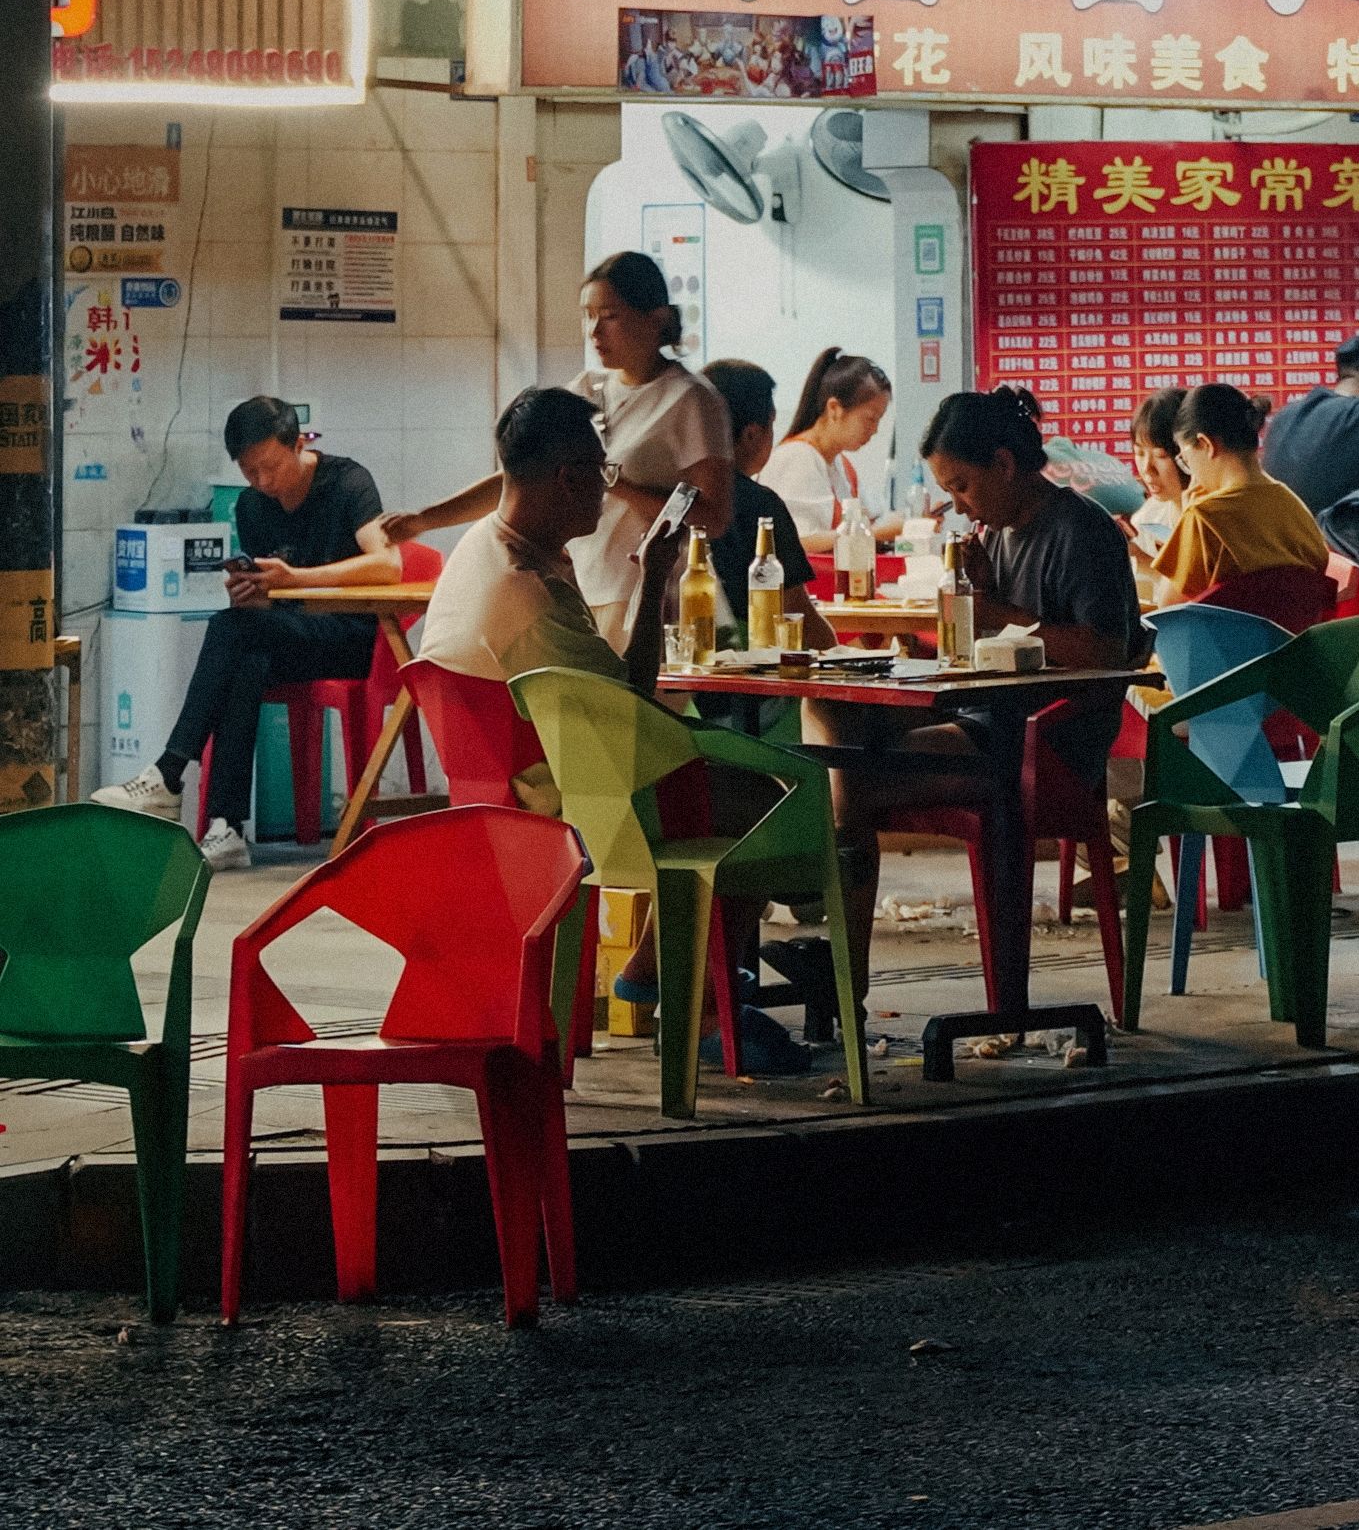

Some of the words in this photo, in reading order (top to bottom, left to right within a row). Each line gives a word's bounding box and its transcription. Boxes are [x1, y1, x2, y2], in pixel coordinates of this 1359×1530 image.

[874, 27, 952, 87] 花
[1015, 31, 1270, 93] 风味美食
[71, 165, 171, 197] 小心地滑
[121, 224, 165, 242] 自然味
